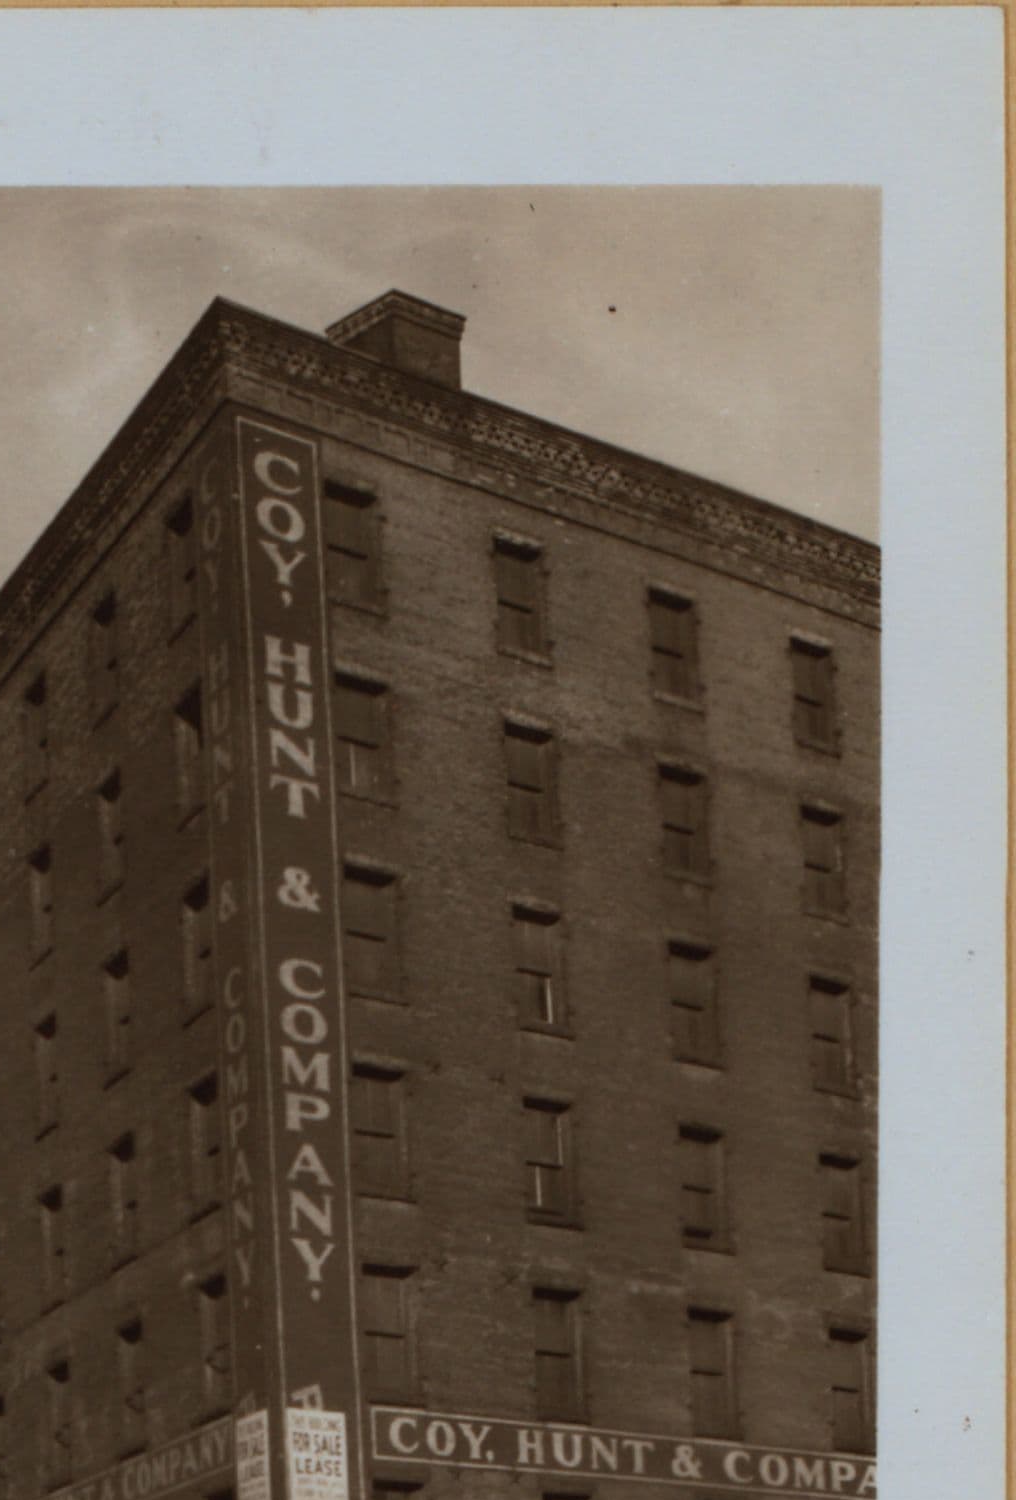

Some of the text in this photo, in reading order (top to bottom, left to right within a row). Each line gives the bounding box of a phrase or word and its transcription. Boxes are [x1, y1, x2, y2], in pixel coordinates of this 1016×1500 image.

[263, 634, 321, 820] HUNT
[277, 866, 323, 914] &
[295, 1458, 343, 1478] LEASE
[314, 1433, 343, 1457] SALE
[516, 1428, 655, 1475] HUNT
[670, 1444, 703, 1481] &
